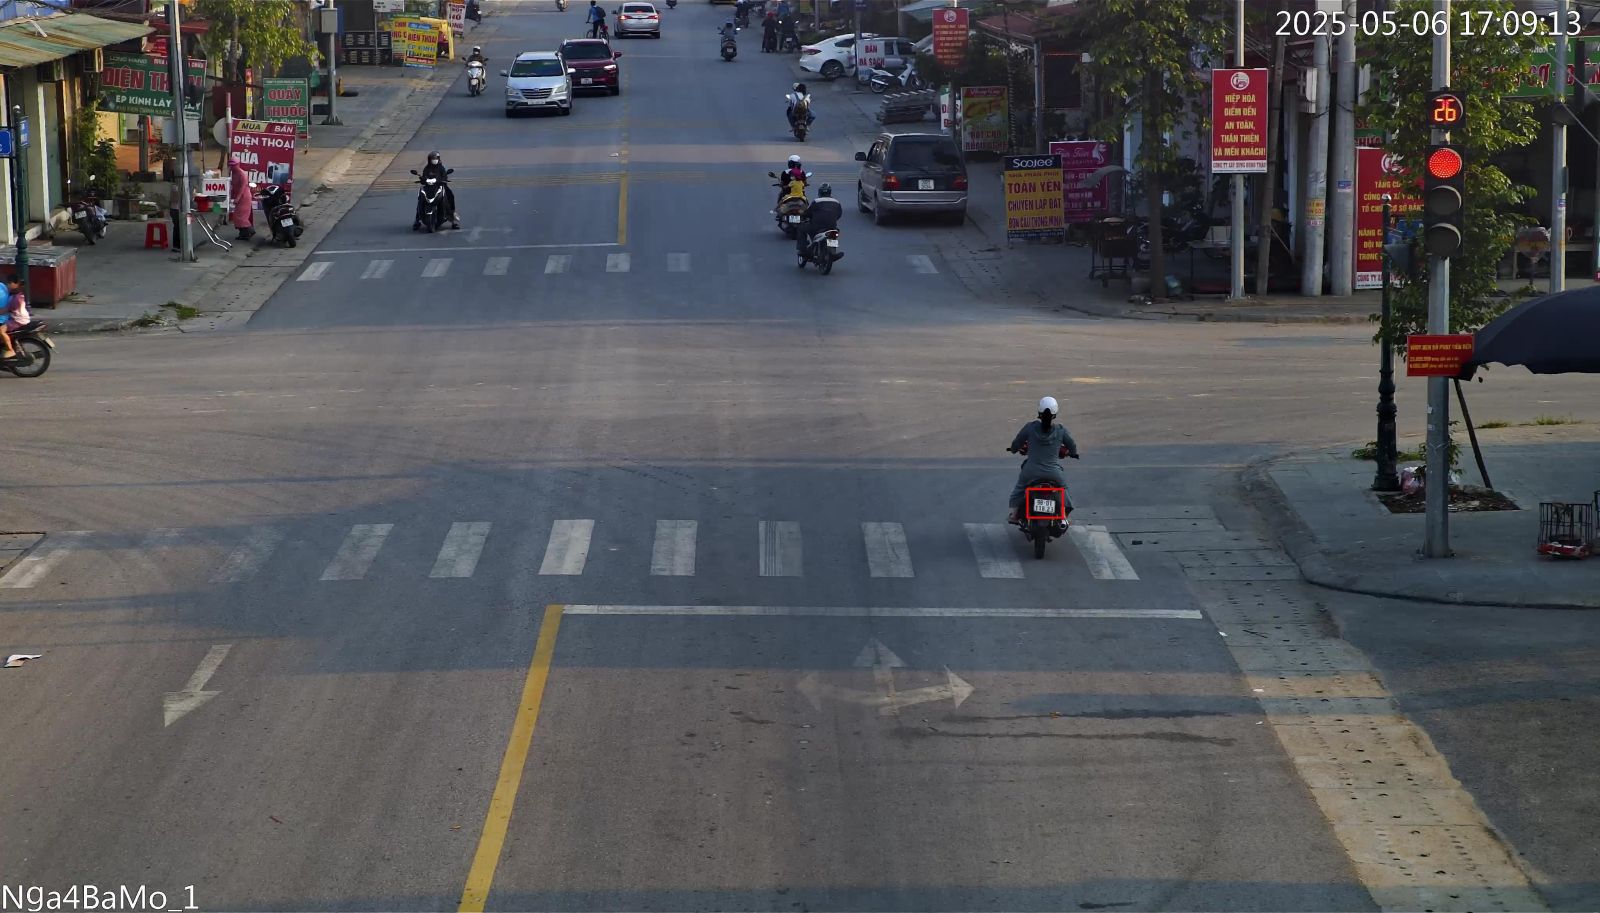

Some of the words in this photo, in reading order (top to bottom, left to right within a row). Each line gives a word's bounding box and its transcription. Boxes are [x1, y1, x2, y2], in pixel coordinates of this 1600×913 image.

[1225, 93, 1241, 104] HIỆP
[1242, 92, 1256, 103] HÒA
[265, 103, 307, 118] THUỐC
[1224, 105, 1242, 116] ĐIỂM
[1242, 105, 1257, 116] ĐẾN
[1434, 98, 1457, 122] 26
[241, 123, 261, 131] MUA
[274, 125, 294, 133] BÁN
[1225, 121, 1234, 130] AN
[234, 135, 259, 148] ĐIỆN
[261, 138, 294, 151] THOẠI
[1220, 133, 1239, 143] THÂN
[1240, 133, 1260, 145] THIỆN
[1214, 146, 1223, 156] VÀ
[1224, 145, 1240, 156] MẾN
[1241, 146, 1266, 156] KHÁCH!
